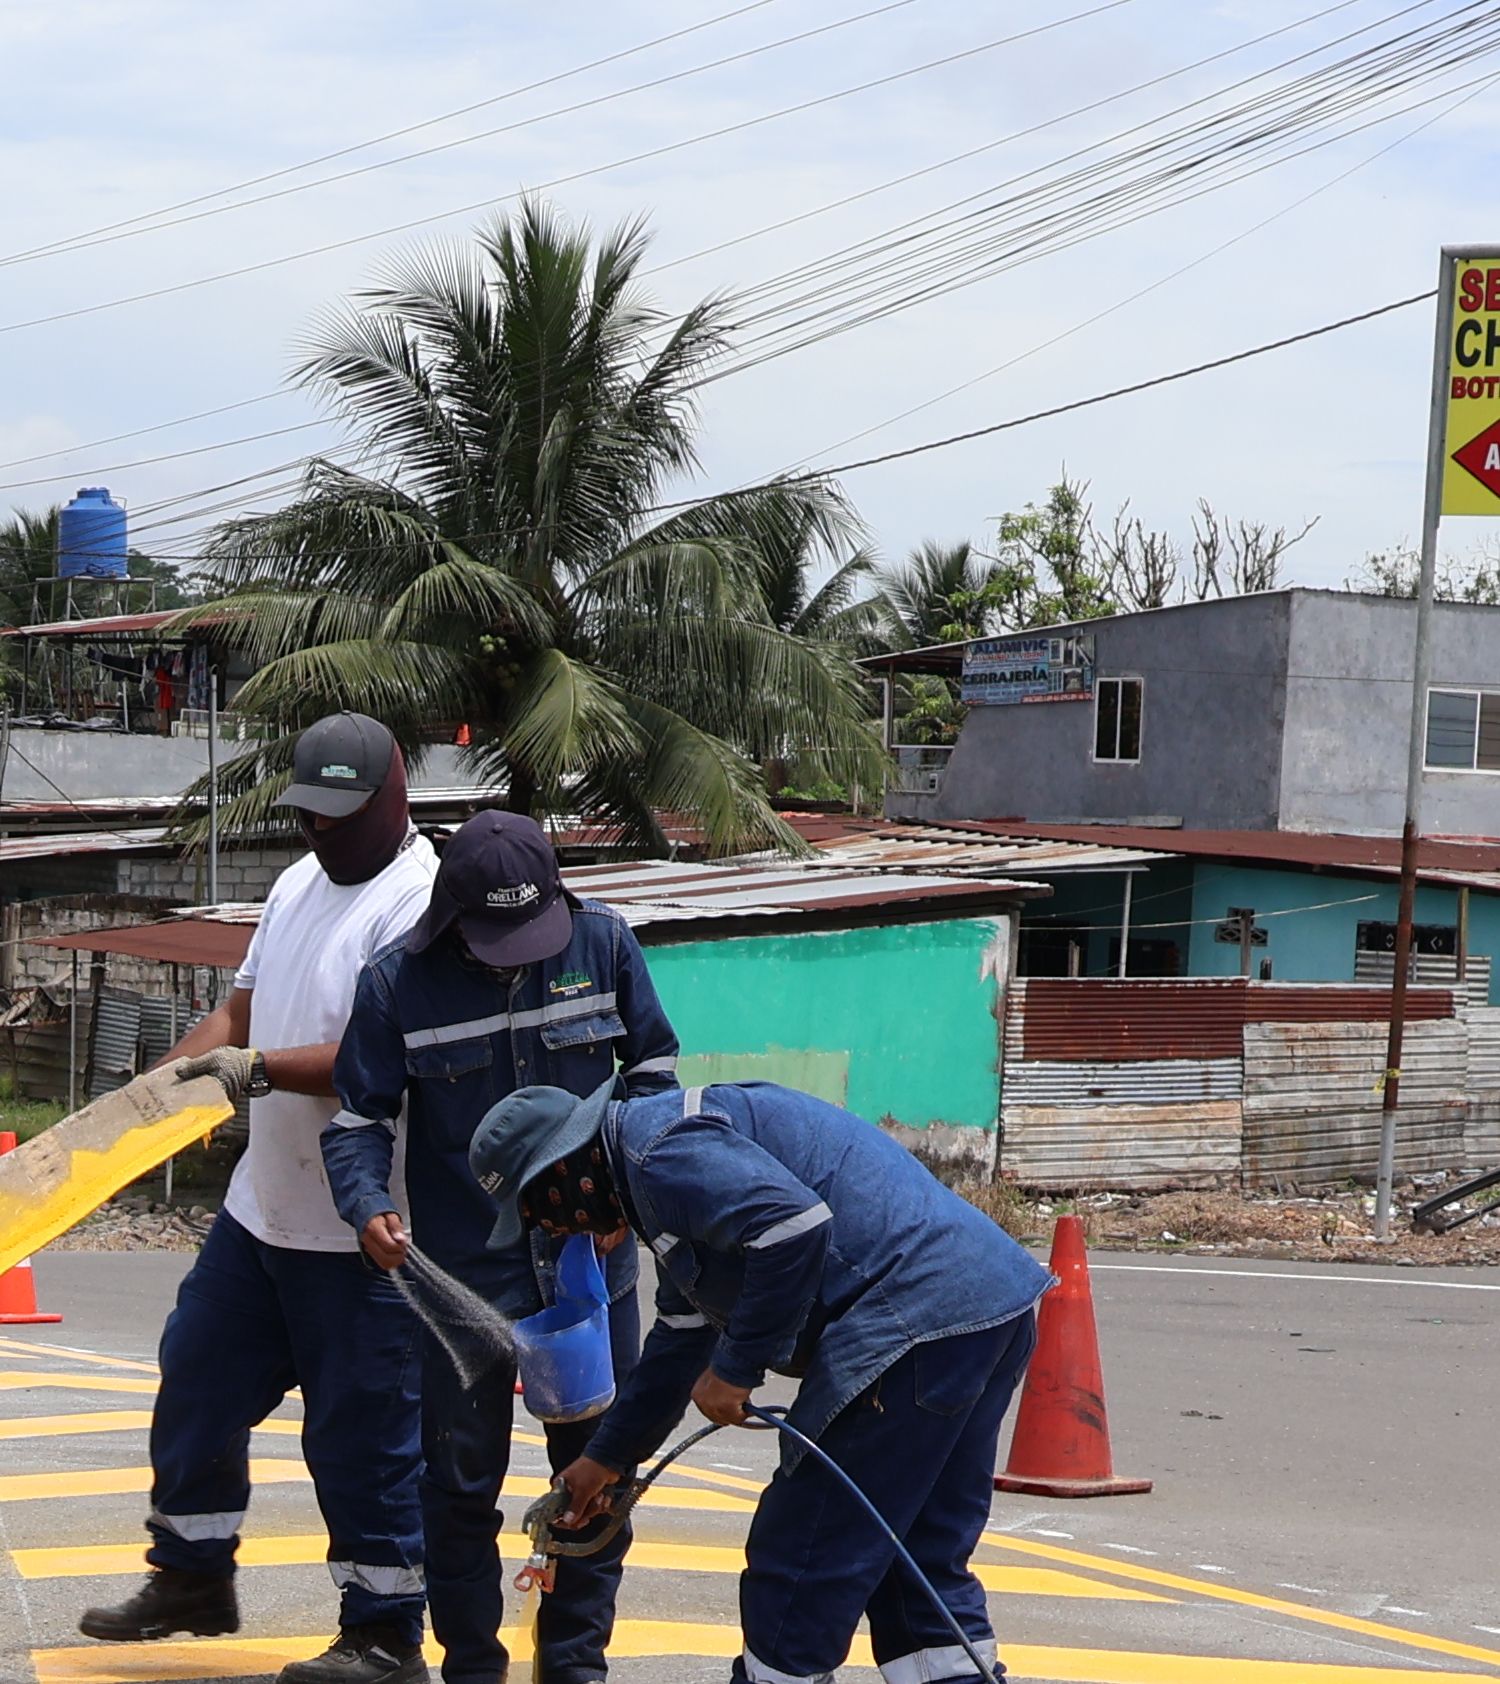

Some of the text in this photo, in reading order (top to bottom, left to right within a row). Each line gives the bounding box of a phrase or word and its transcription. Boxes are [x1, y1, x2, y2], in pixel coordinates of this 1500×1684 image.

[1484, 443, 1500, 470] A
[962, 666, 1048, 684] CERRAJERÍA
[487, 884, 538, 902] ORELLANA
